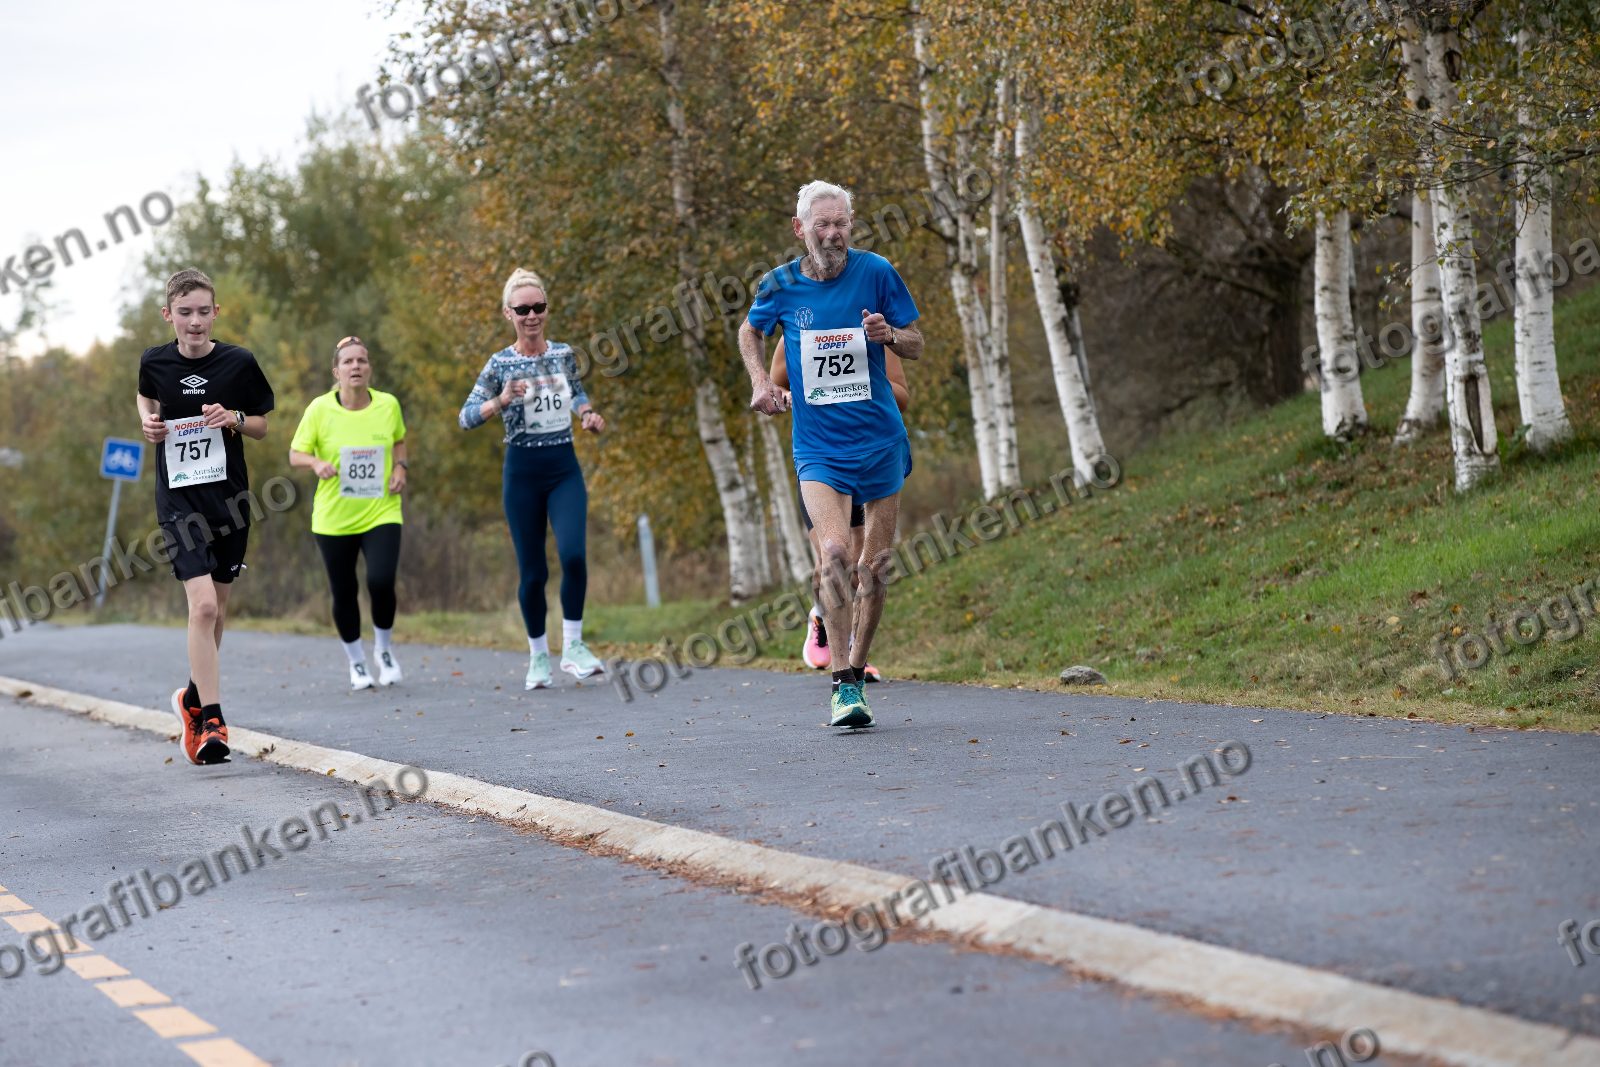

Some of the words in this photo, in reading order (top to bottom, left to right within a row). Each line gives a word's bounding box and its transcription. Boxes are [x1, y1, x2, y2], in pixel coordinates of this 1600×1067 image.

[814, 334, 853, 343] NORGES
[818, 342, 847, 350] LØPET
[813, 353, 855, 377] 752
[183, 387, 205, 395] umbro
[832, 384, 868, 393] Aurskog
[534, 394, 562, 412] 216
[178, 427, 205, 437] LØPET
[174, 438, 211, 463] 757
[349, 464, 376, 479] 832
